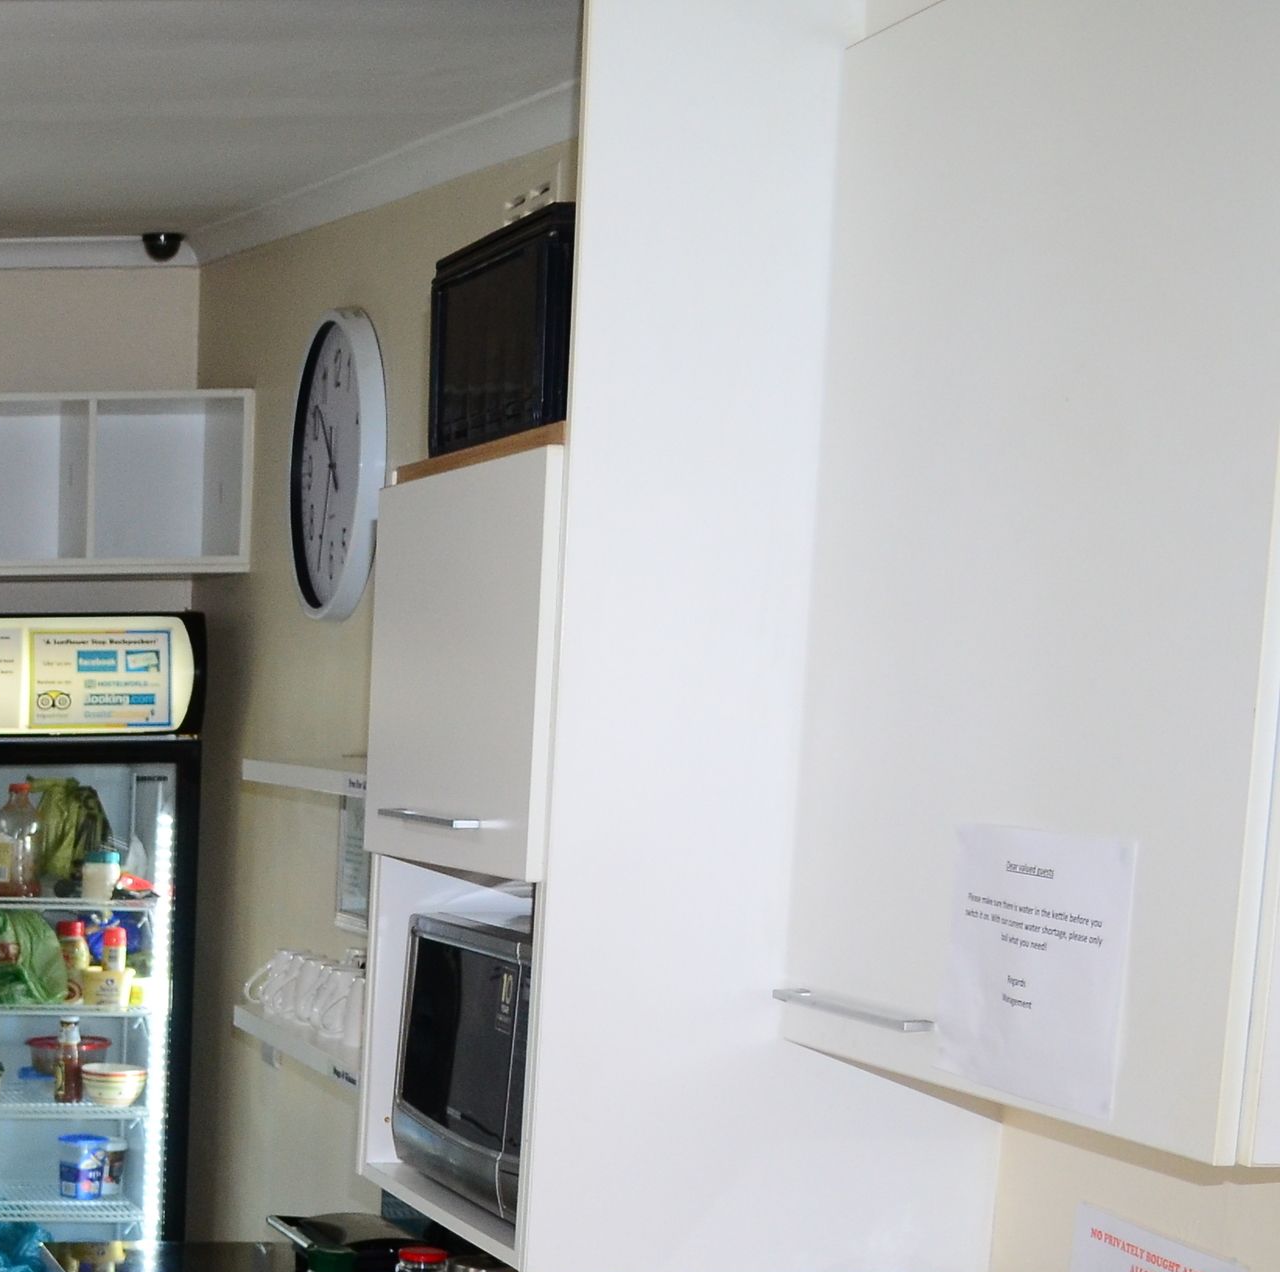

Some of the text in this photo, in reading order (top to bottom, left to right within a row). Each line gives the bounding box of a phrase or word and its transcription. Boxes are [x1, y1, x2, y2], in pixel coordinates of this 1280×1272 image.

[79, 656, 118, 667] facebook
[1090, 1227, 1103, 1241] NO
[1104, 1232, 1145, 1260] PRIVATELY
